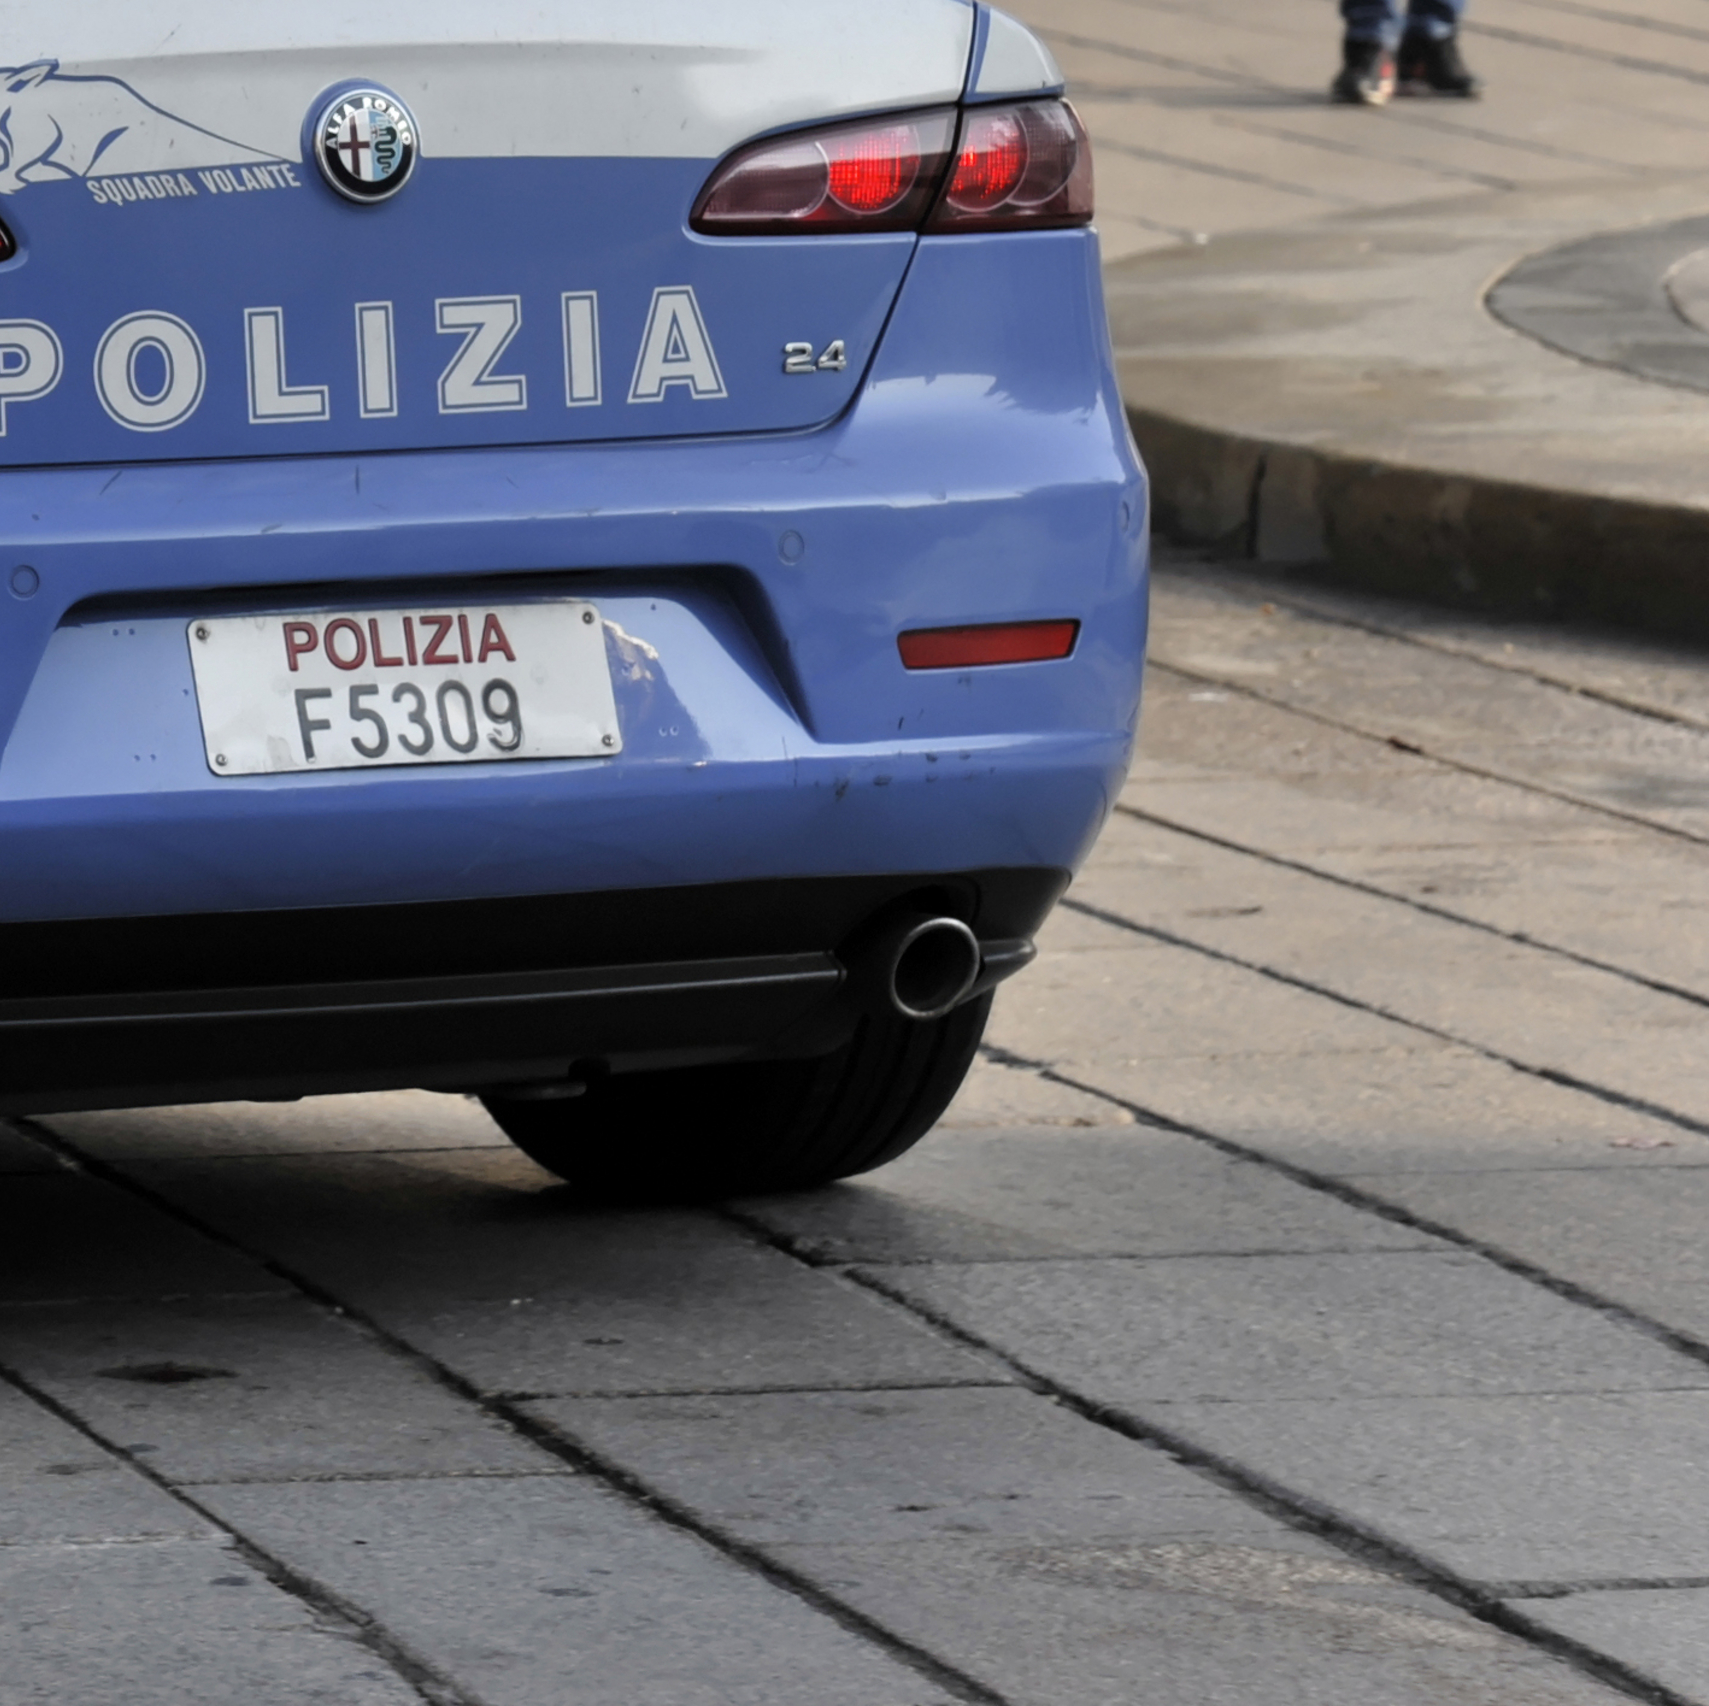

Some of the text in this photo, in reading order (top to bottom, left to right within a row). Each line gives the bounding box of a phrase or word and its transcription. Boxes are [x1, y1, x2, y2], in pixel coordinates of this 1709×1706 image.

[325, 96, 412, 150] ALFA ROMEO
[86, 162, 301, 206] SQUADRA VOLANTE
[282, 613, 517, 672] POLIZIA
[293, 677, 524, 763] F5309
